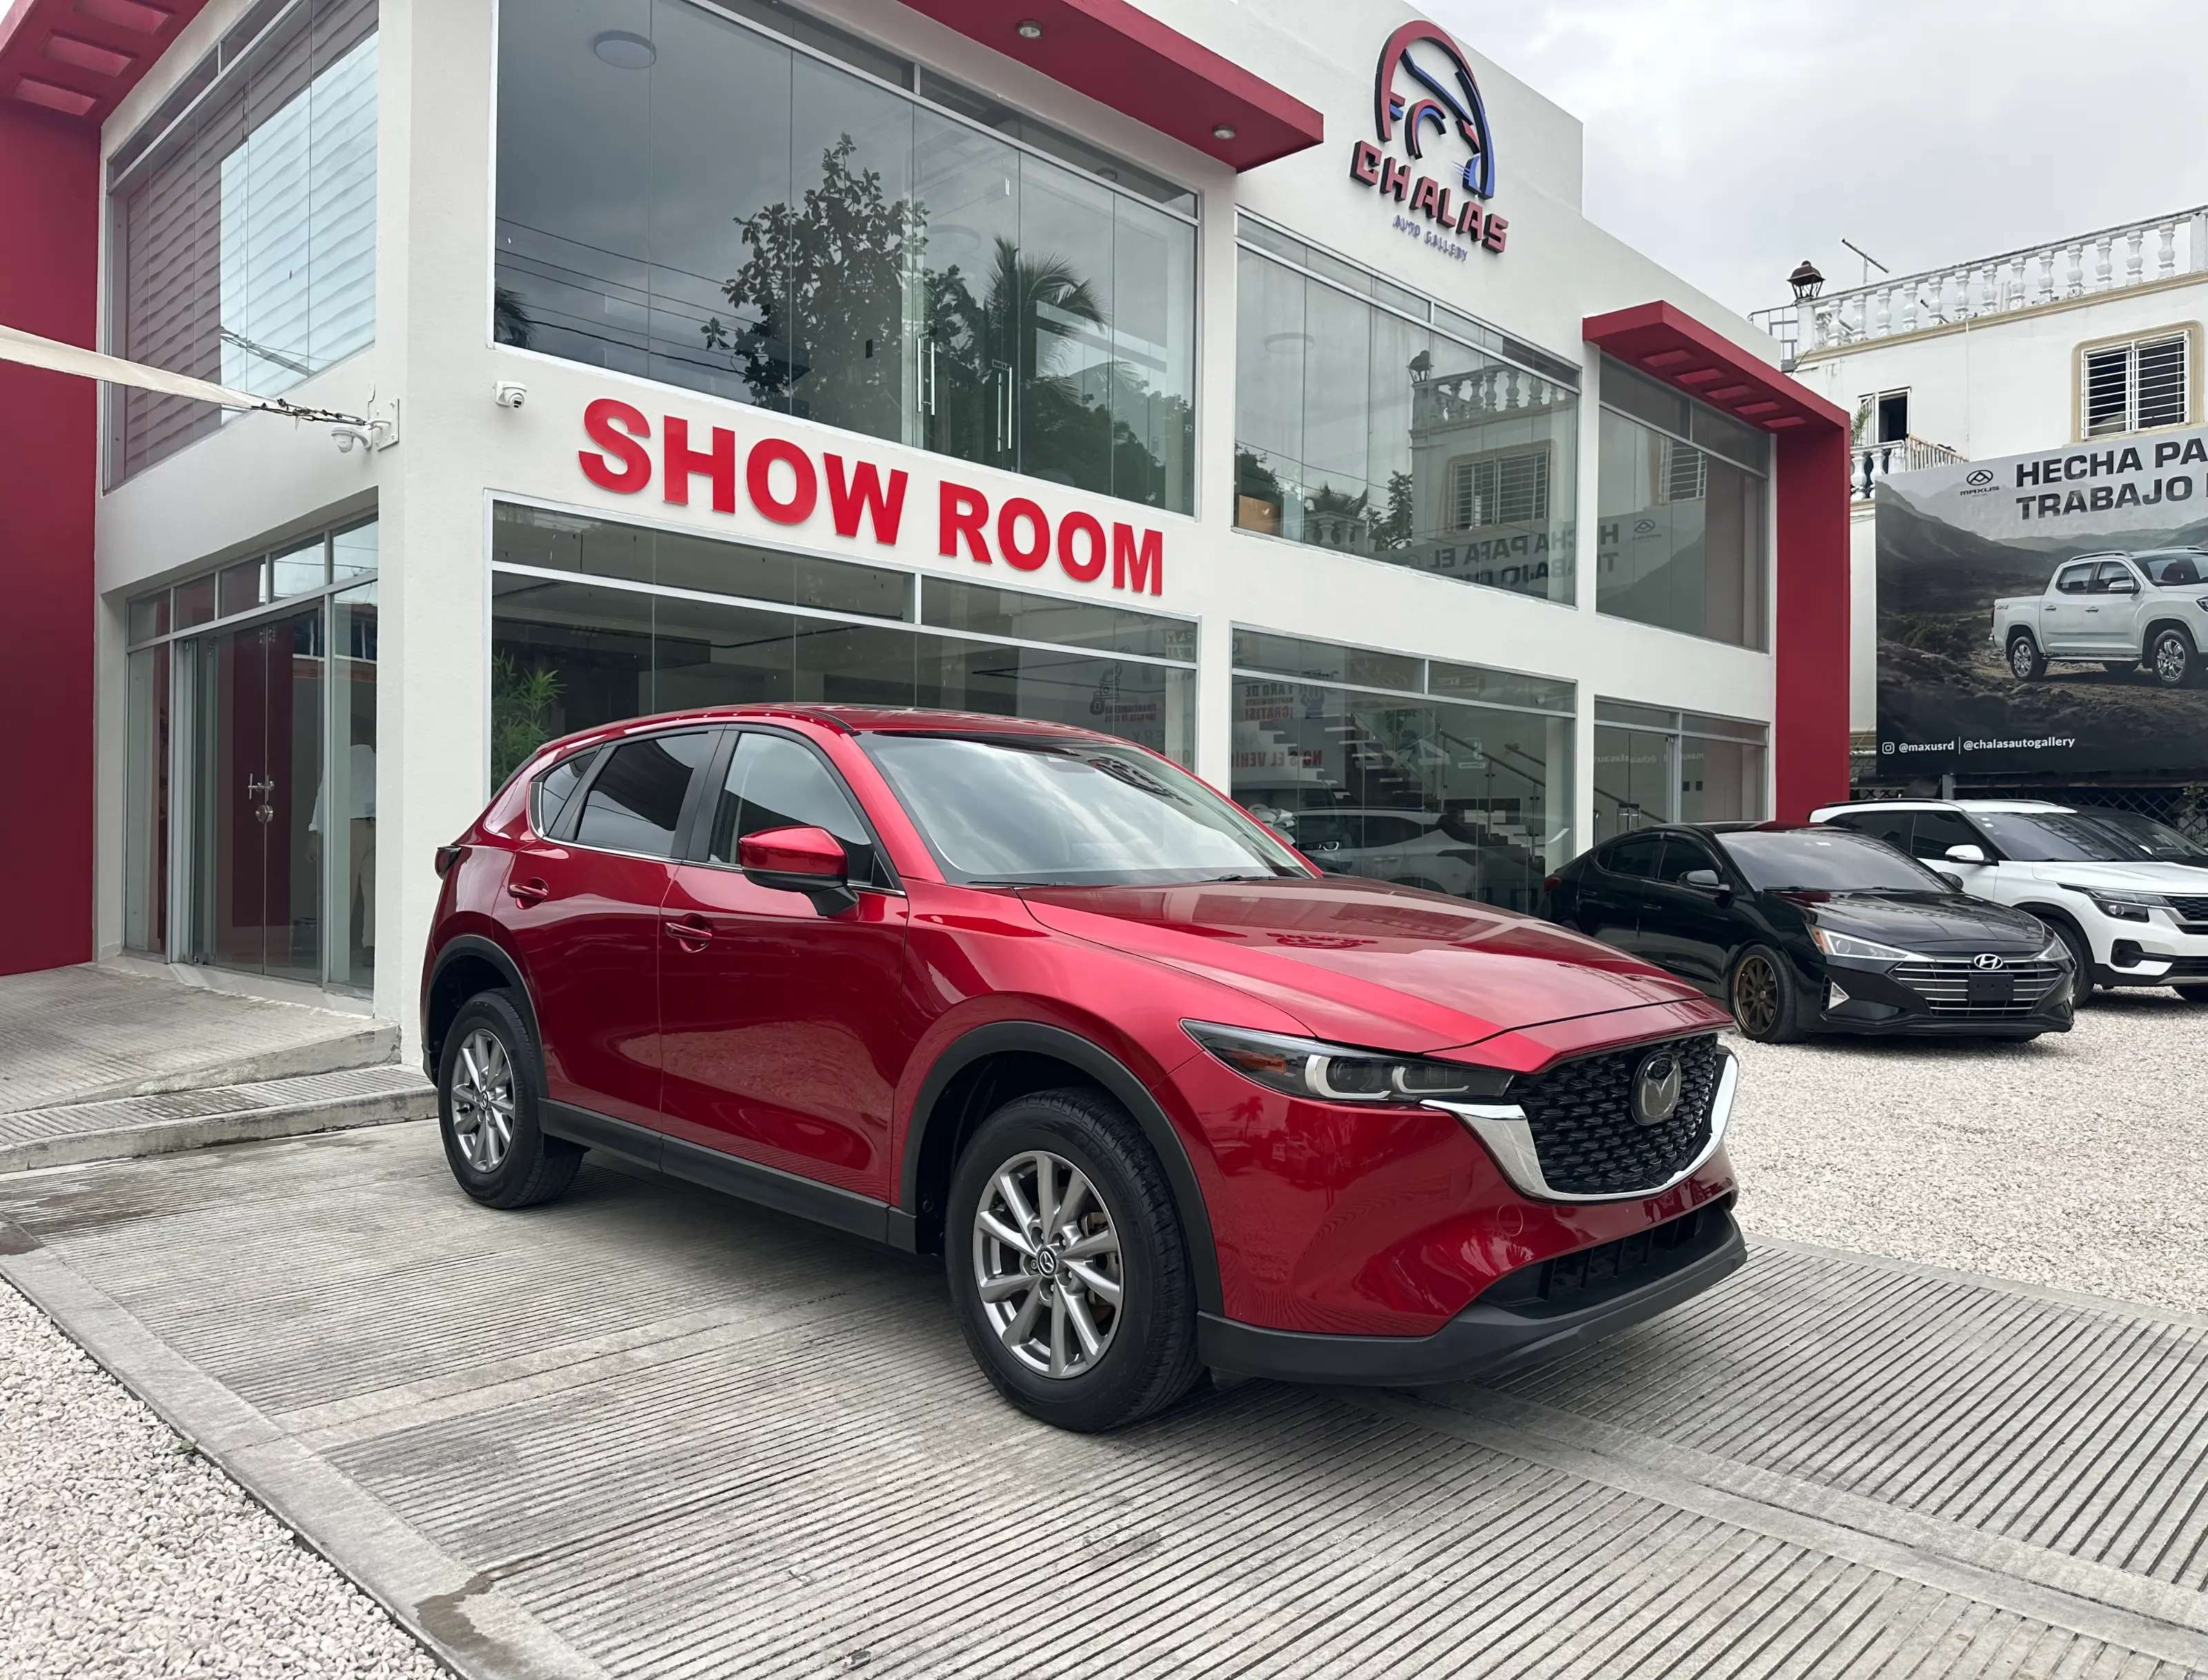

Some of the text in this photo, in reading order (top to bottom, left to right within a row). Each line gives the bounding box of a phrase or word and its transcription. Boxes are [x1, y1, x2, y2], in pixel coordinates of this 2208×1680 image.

[1350, 140, 1509, 254] CHALAS
[1392, 215, 1468, 262] AUTO GALLERY
[2015, 446, 2142, 488] HECHA
[578, 397, 1164, 597] SHOW ROOM
[1960, 486, 2000, 496] MAXUS
[2015, 475, 2193, 520] TRABAJO
[1899, 736, 2076, 753] @maxusrd @chalasautogallery
